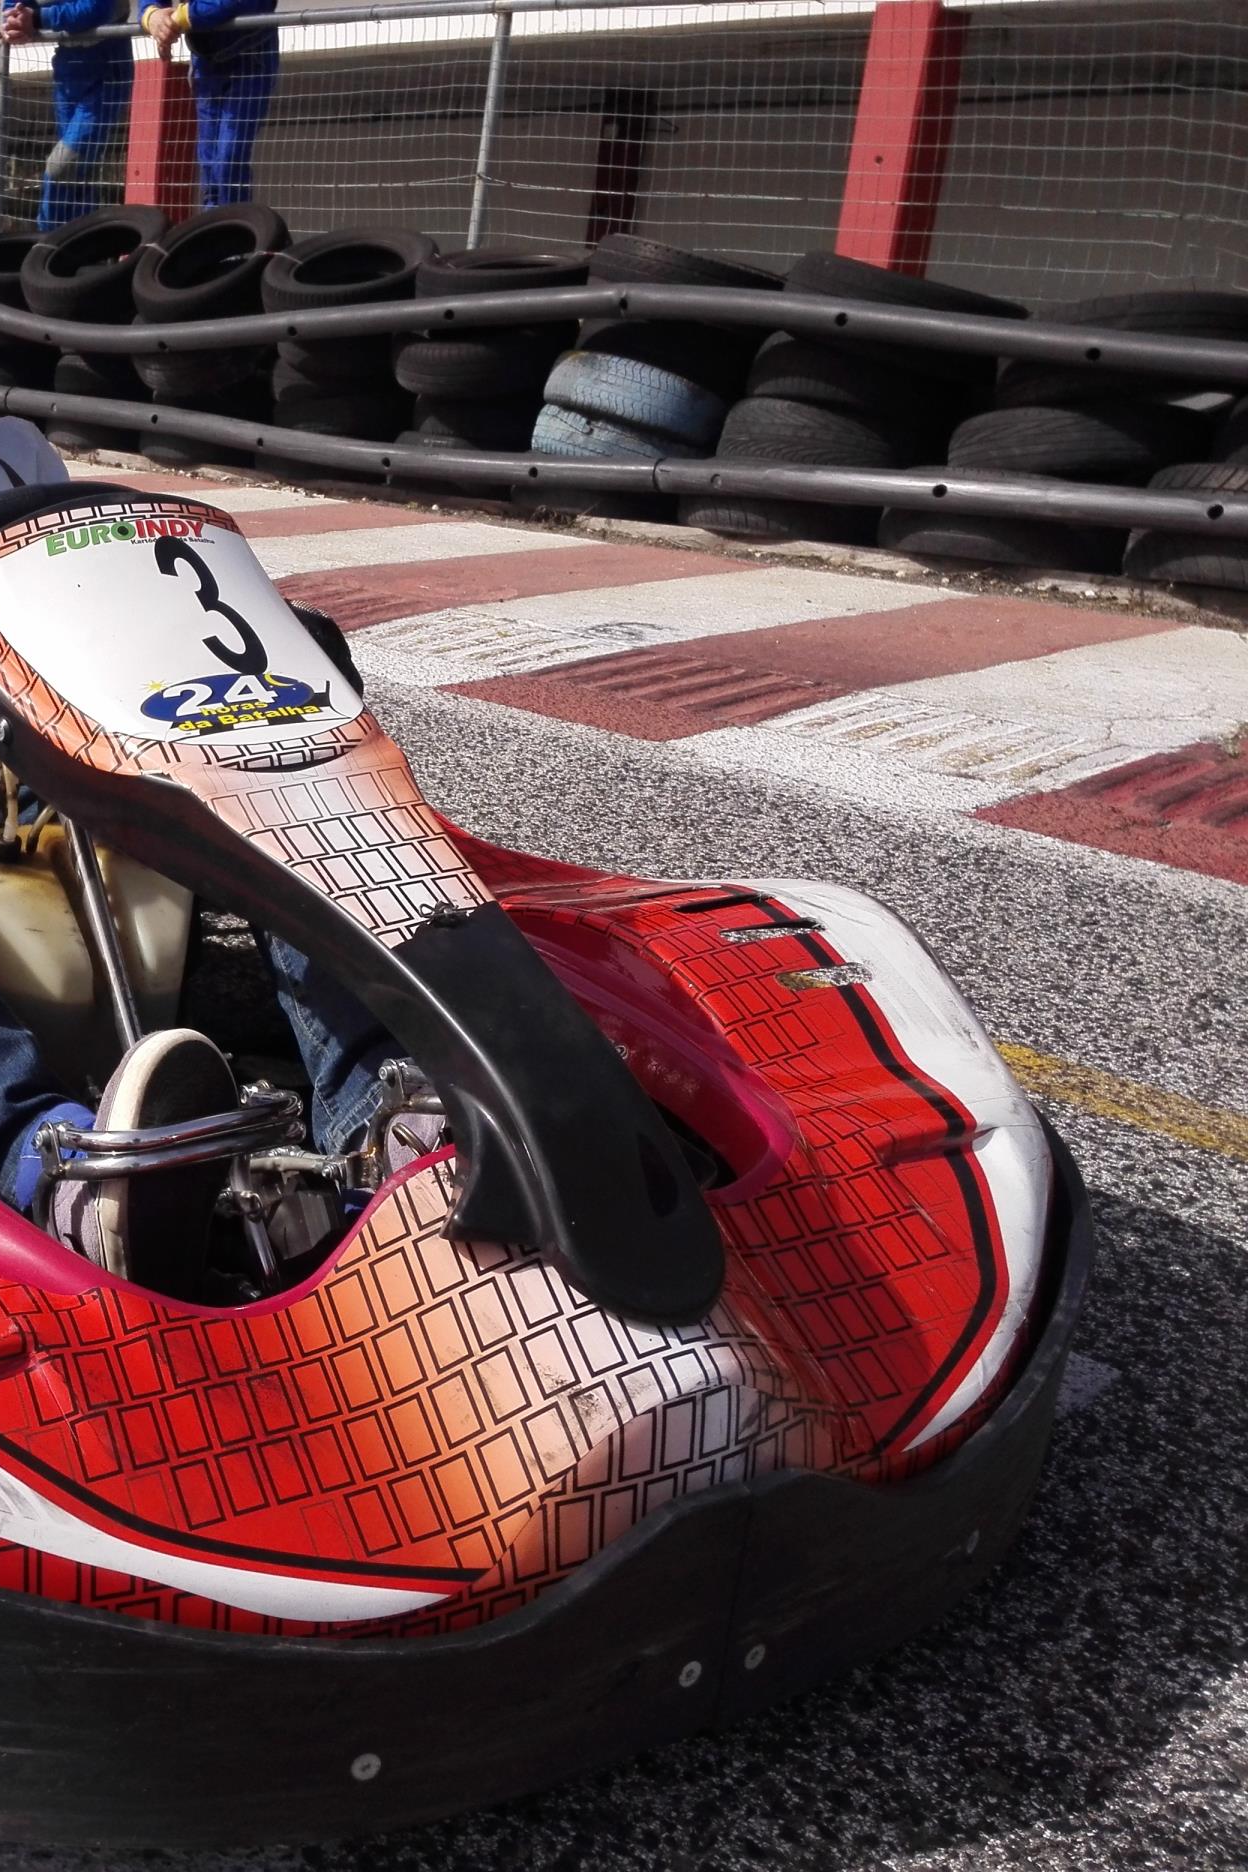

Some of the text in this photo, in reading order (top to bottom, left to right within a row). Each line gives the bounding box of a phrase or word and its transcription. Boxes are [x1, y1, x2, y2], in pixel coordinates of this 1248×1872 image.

[154, 534, 268, 676] 3
[162, 674, 278, 717] 24
[200, 700, 269, 717] horas
[177, 703, 321, 732] da Batalha
